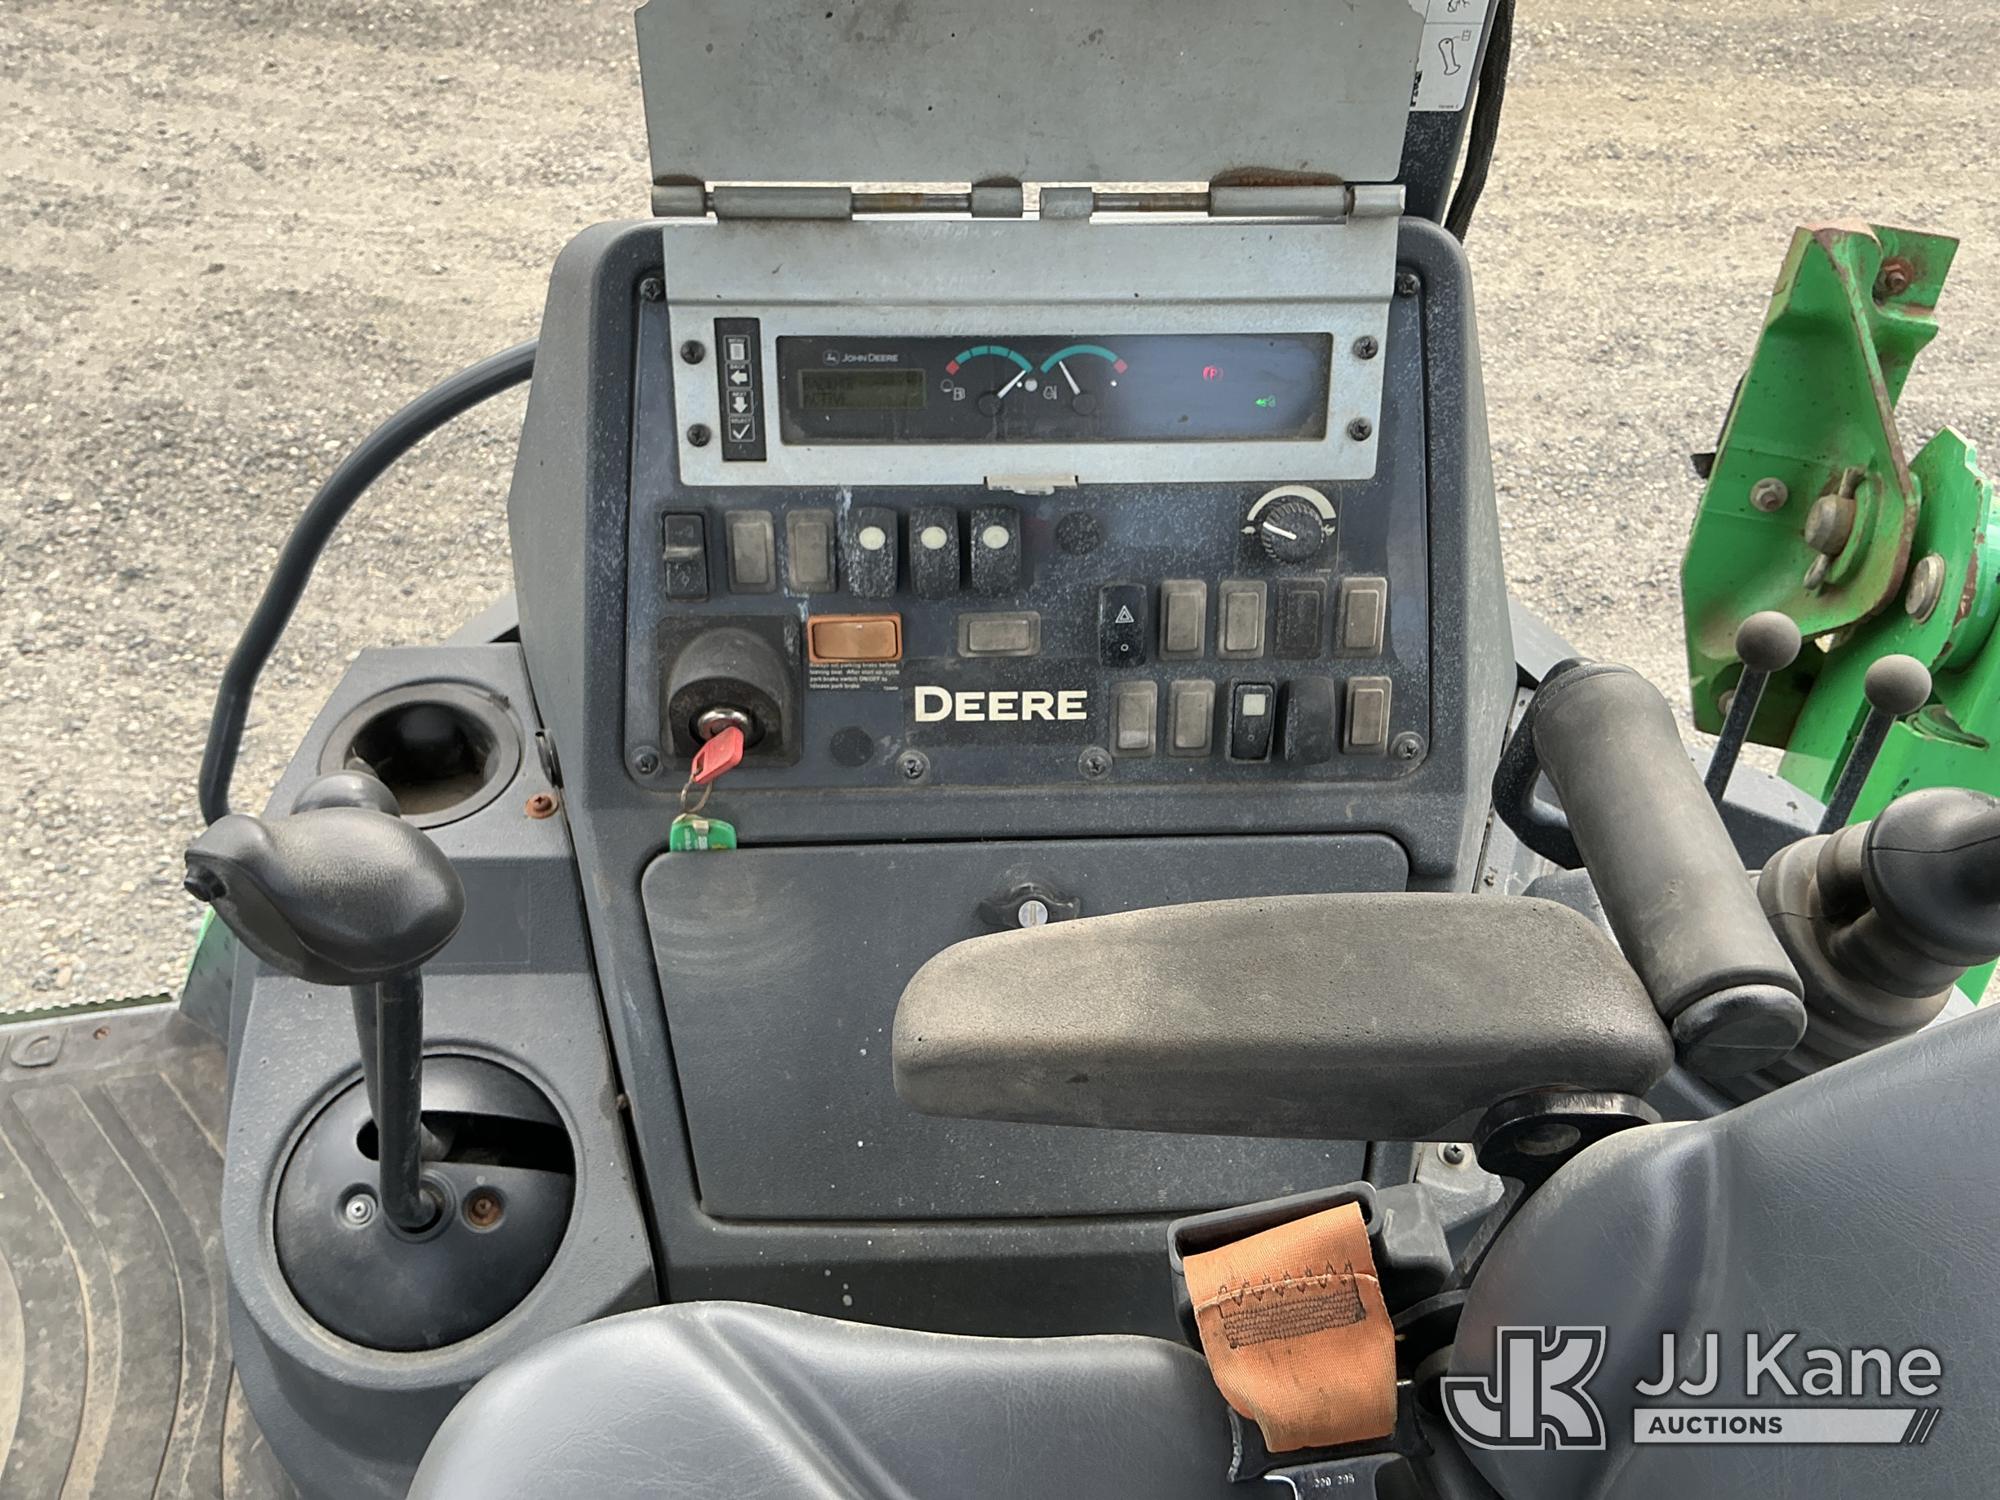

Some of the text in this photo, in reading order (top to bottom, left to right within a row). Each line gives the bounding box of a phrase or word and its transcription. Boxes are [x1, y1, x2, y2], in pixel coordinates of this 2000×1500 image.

[842, 353, 899, 363] JOHN DEERE
[914, 685, 1088, 722] DEERE
